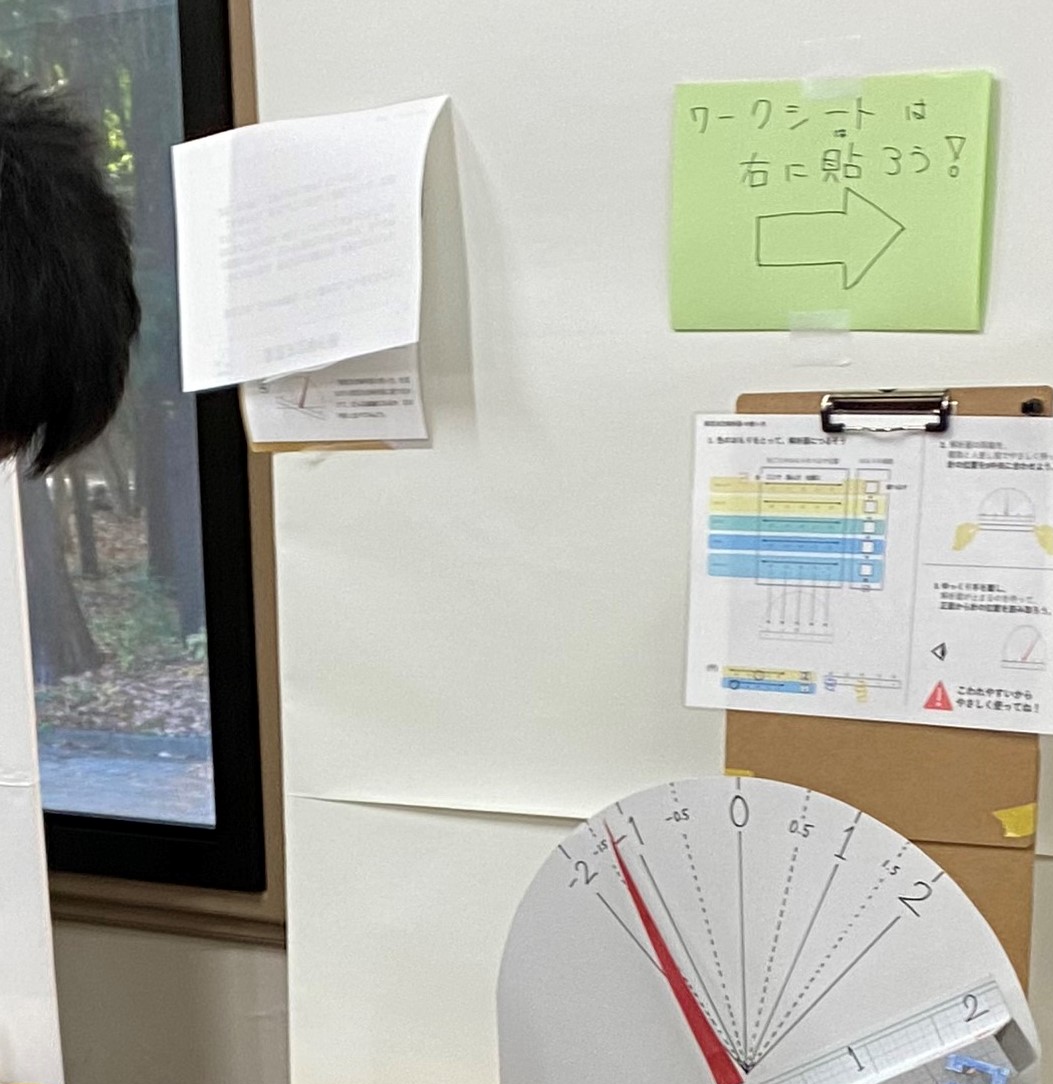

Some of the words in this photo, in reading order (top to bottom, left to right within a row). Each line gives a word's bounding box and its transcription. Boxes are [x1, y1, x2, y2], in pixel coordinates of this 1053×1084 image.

[689, 96, 926, 134] ワークシートは
[729, 795, 750, 828] 0
[789, 820, 815, 838] 0.5
[834, 824, 857, 861] 1
[568, 860, 599, 888] -2
[880, 859, 901, 876] 1.5
[898, 881, 933, 918] 2
[962, 994, 989, 1023] 2
[846, 1045, 865, 1073] 1
